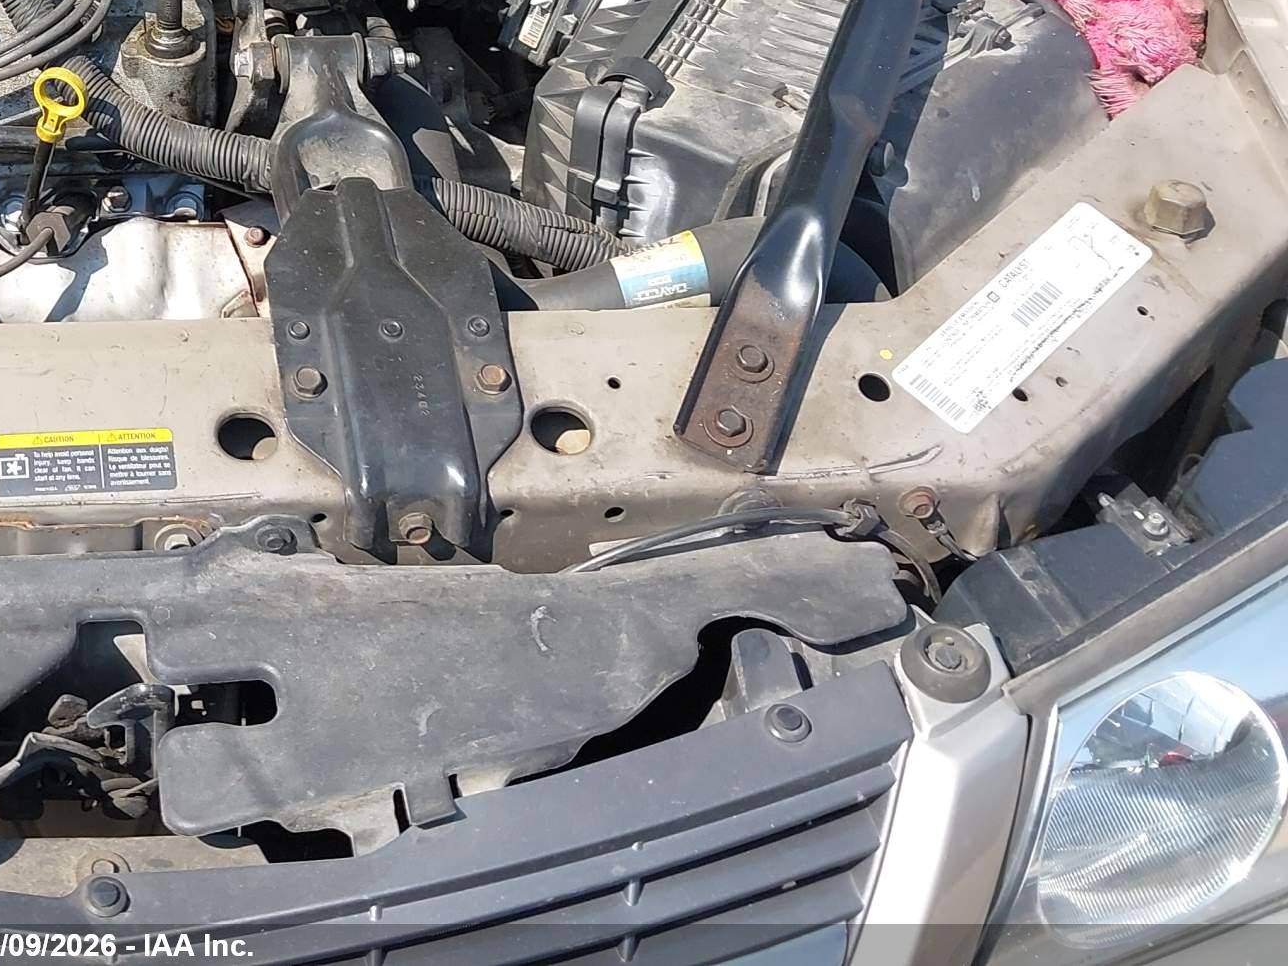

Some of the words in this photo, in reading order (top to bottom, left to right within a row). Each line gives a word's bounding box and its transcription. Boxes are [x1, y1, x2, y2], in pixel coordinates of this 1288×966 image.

[997, 258, 1034, 288] CATALYST
[634, 282, 690, 301] DAYCO
[119, 432, 156, 440] ATTENTION
